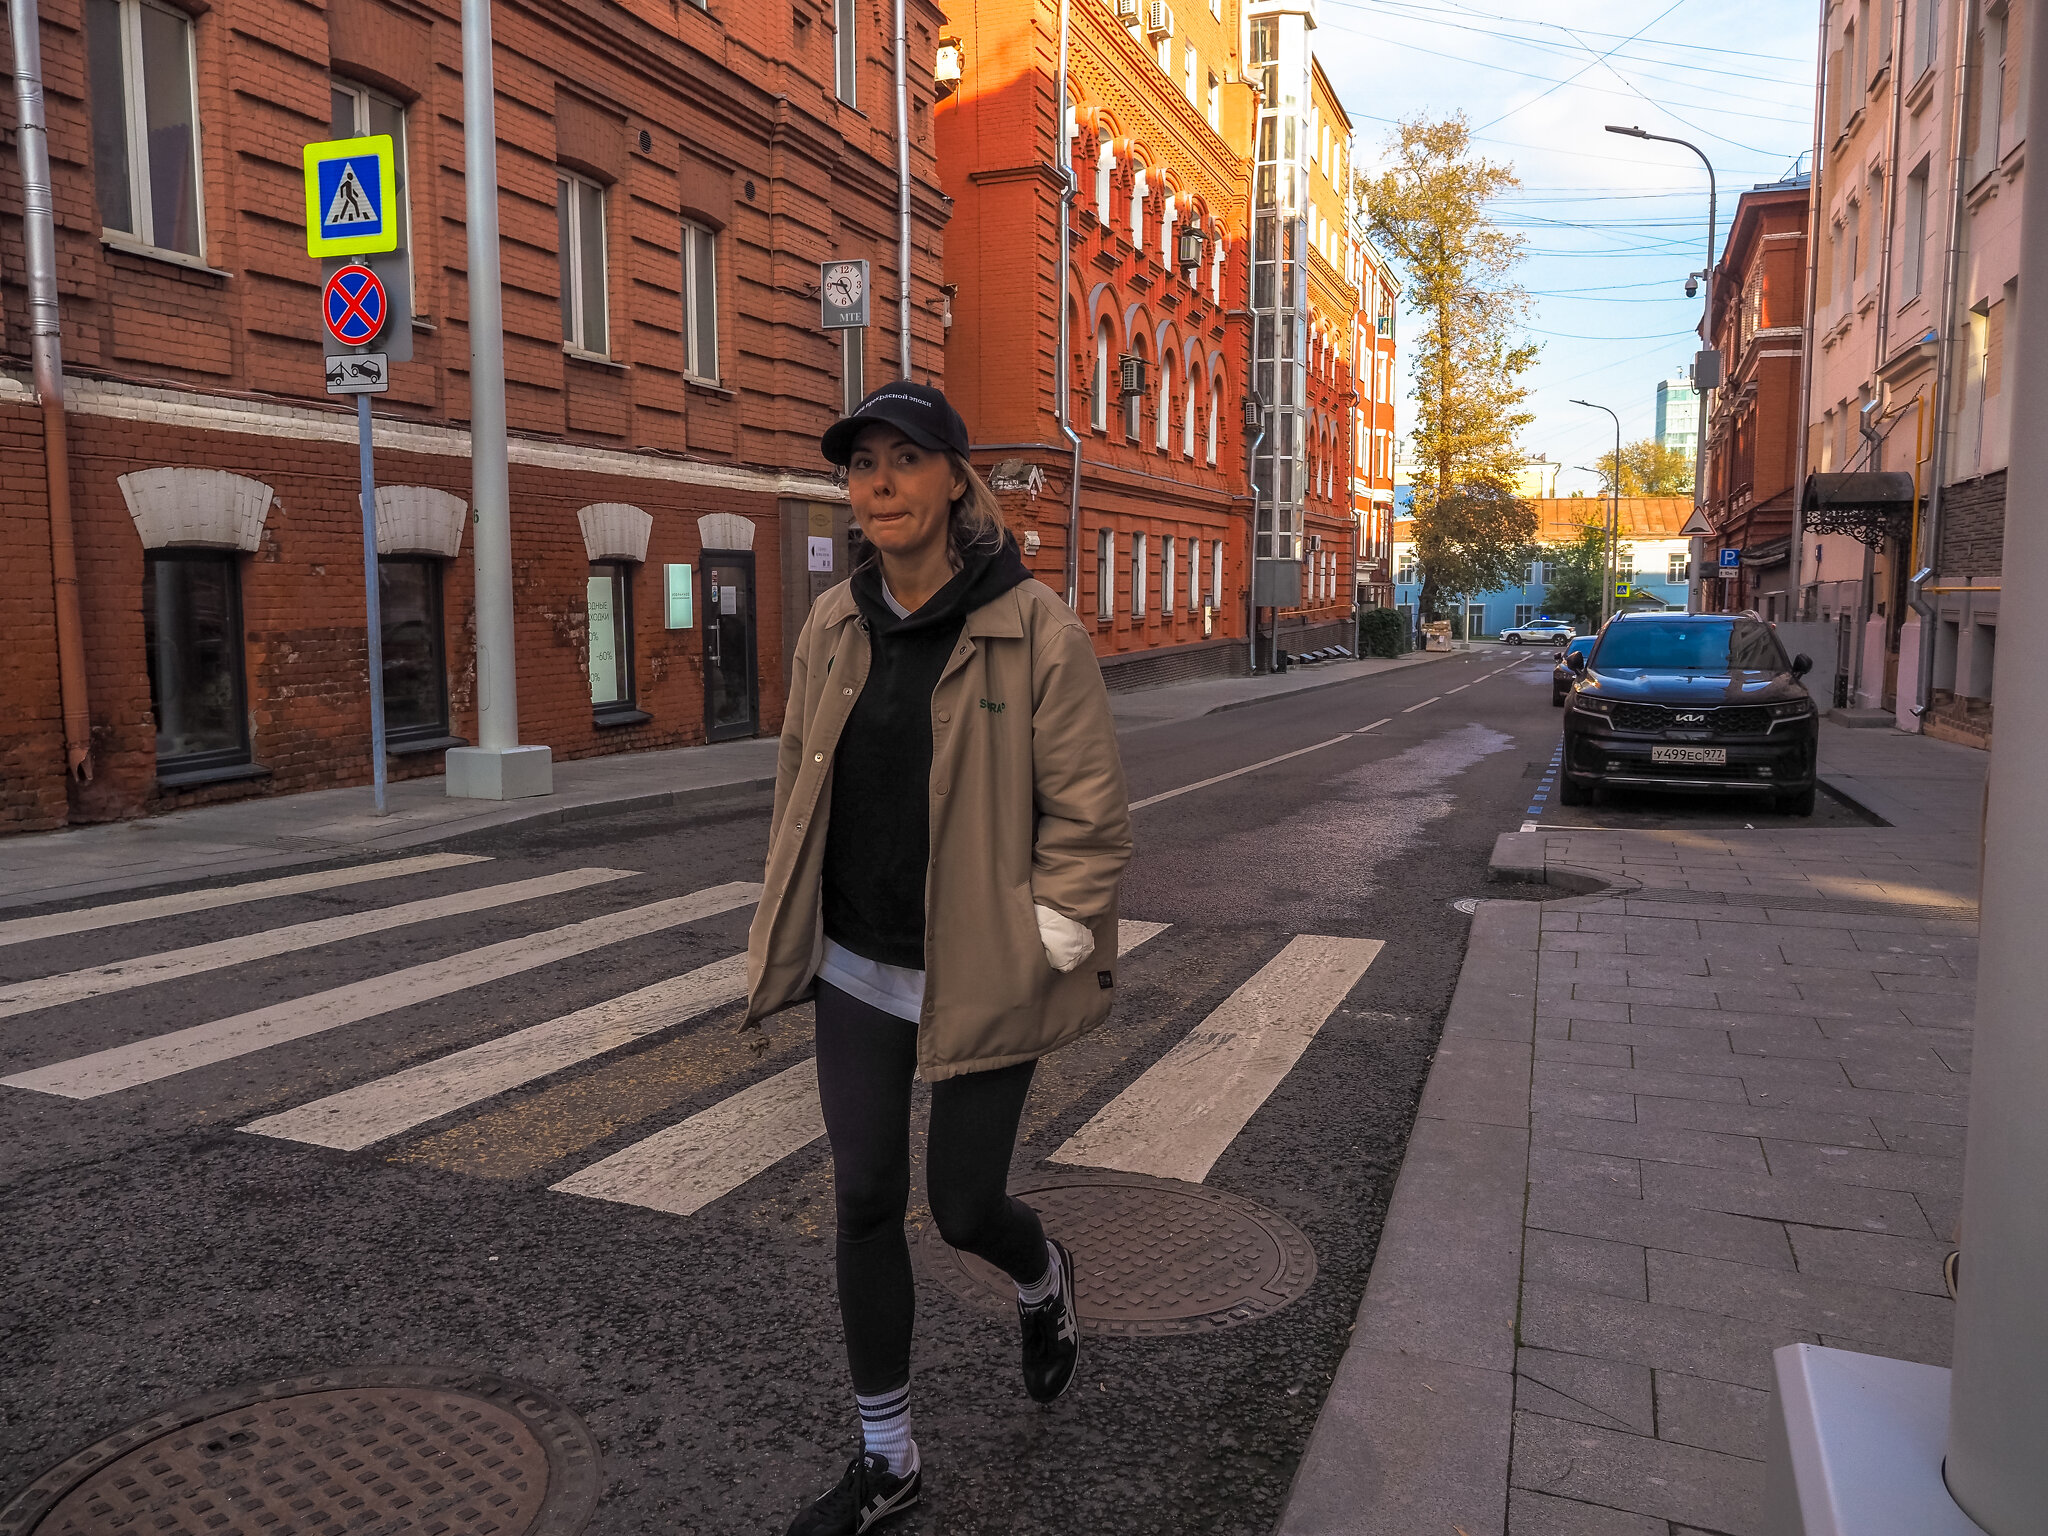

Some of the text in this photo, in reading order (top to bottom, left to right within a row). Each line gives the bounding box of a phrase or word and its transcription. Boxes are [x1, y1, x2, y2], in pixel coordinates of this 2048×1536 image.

[840, 265, 849, 274] 12
[826, 282, 832, 290] 9
[856, 281, 862, 289] 3
[841, 297, 847, 305] 6
[908, 396, 932, 408] эпохи
[473, 508, 480, 524] 6
[1724, 551, 1735, 564] P
[1704, 750, 1722, 758] 977
